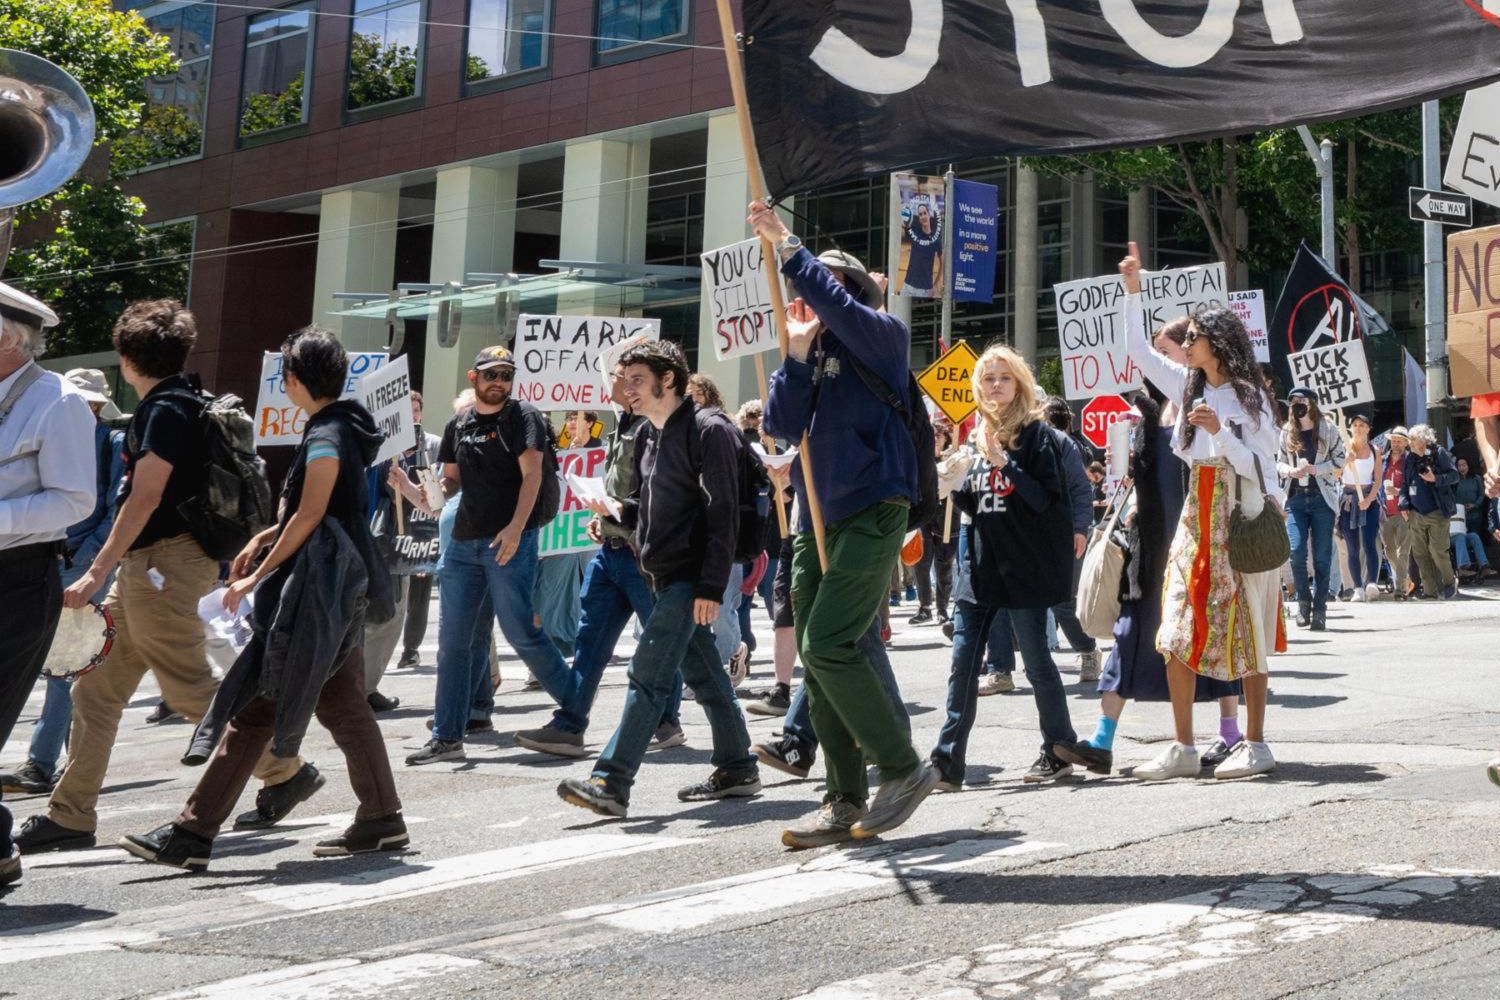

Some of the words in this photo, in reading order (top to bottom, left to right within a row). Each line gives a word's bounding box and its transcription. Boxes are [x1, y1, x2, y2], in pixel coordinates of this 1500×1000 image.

[1428, 200, 1444, 212] ONE
[1447, 202, 1464, 214] WAY
[705, 250, 743, 286] YOU
[713, 277, 771, 318] STILL
[1059, 274, 1172, 315] GODFAHER
[1175, 271, 1197, 298] OF
[1201, 267, 1222, 293] AI
[1236, 291, 1257, 300] SAID
[524, 318, 562, 342] IN
[571, 320, 590, 347] A
[717, 311, 764, 354] STOP
[1062, 311, 1120, 351] QUIT
[350, 354, 385, 375] OT
[524, 349, 574, 373] OFF
[936, 366, 971, 383] DEA
[1064, 355, 1100, 391] TO
[1292, 347, 1349, 375] FUCK
[1298, 366, 1348, 388] THIS
[366, 392, 375, 414] AI
[376, 374, 409, 410] FREEZE
[518, 381, 545, 403] NO
[550, 383, 594, 404] ONE
[1317, 378, 1362, 406] HIT
[1084, 411, 1118, 432] STO
[394, 535, 441, 559] TORME
